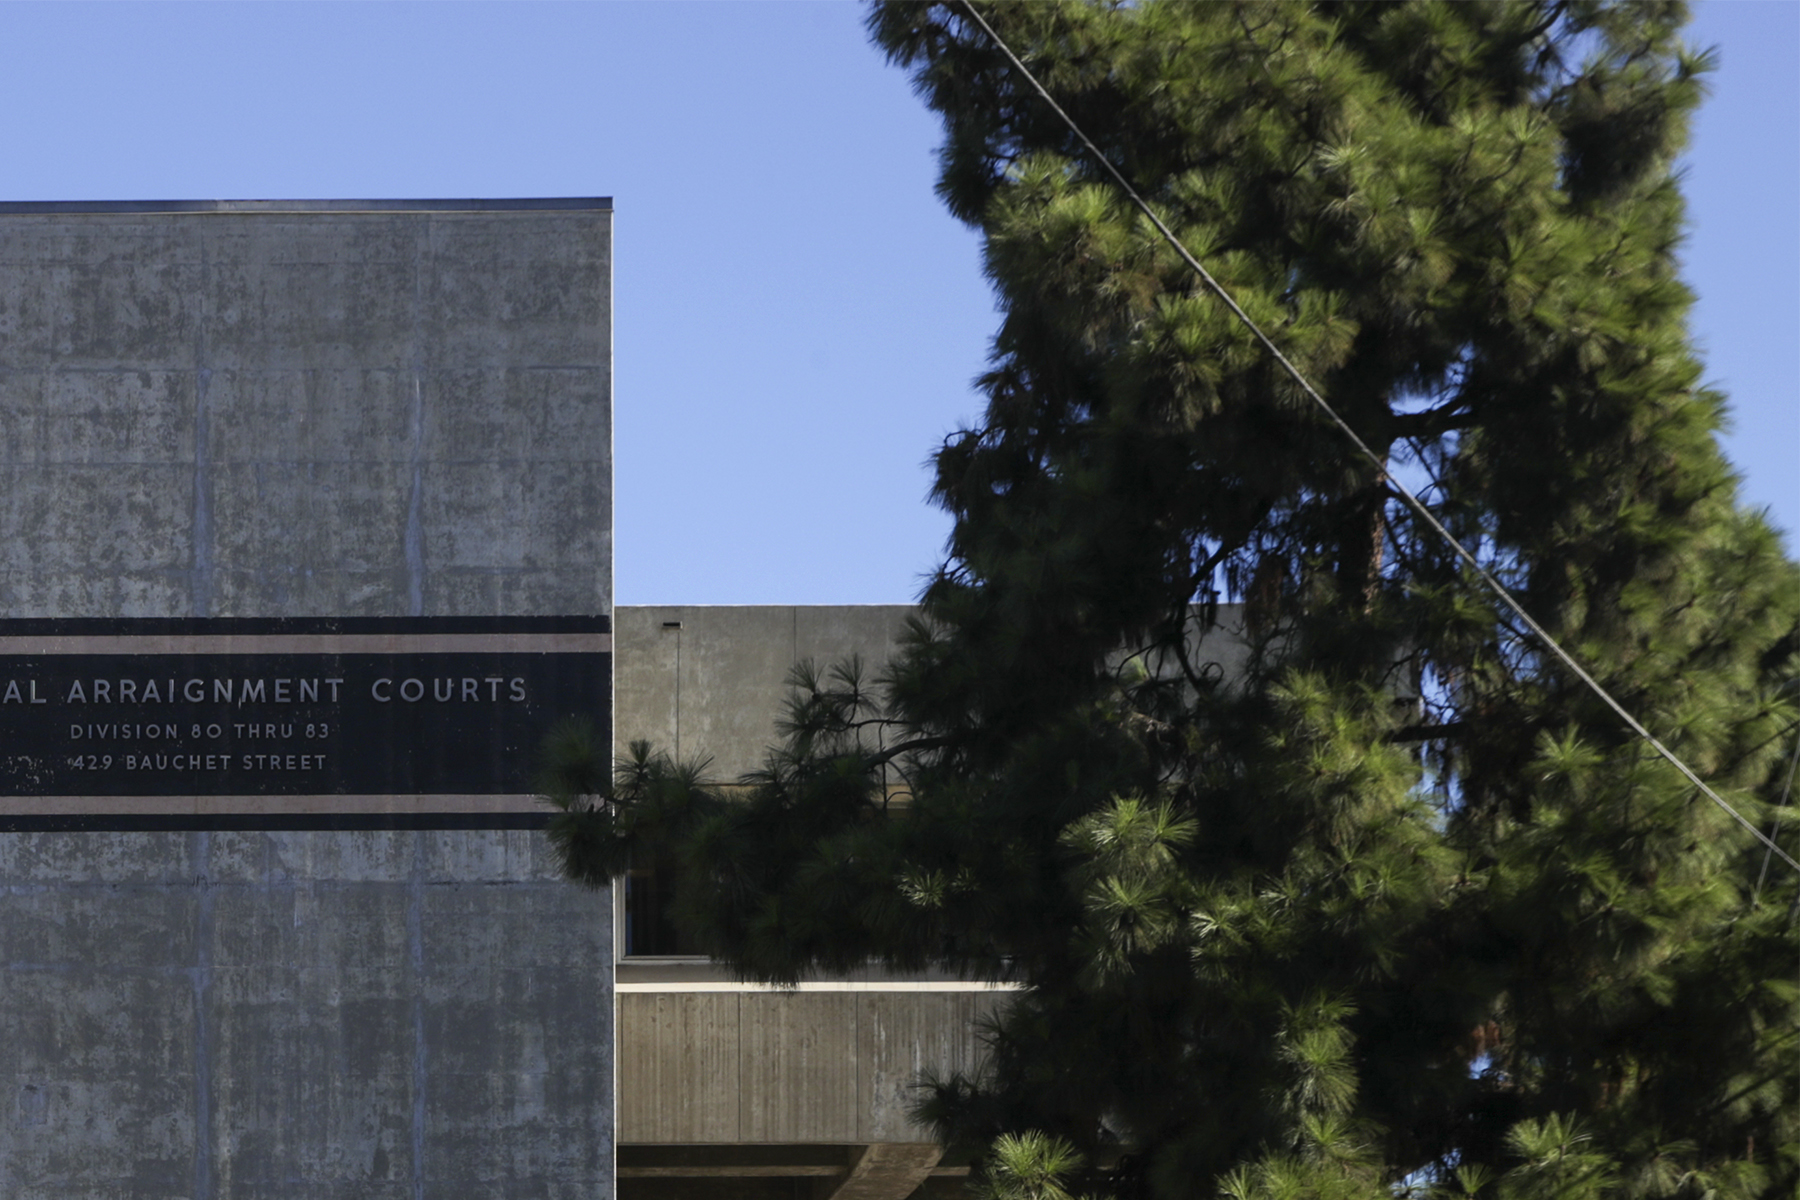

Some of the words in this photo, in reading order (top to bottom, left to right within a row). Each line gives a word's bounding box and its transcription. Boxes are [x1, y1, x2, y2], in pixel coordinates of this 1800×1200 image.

[66, 678, 344, 703] ARRAIGNMENT
[371, 677, 526, 702] COURTS
[70, 724, 178, 739] DIVISION
[191, 724, 222, 739] 80
[234, 724, 293, 738] THRU
[305, 724, 329, 738] 83
[73, 755, 113, 770] 429
[126, 755, 231, 770] BAUCHET
[242, 755, 326, 770] STREET
